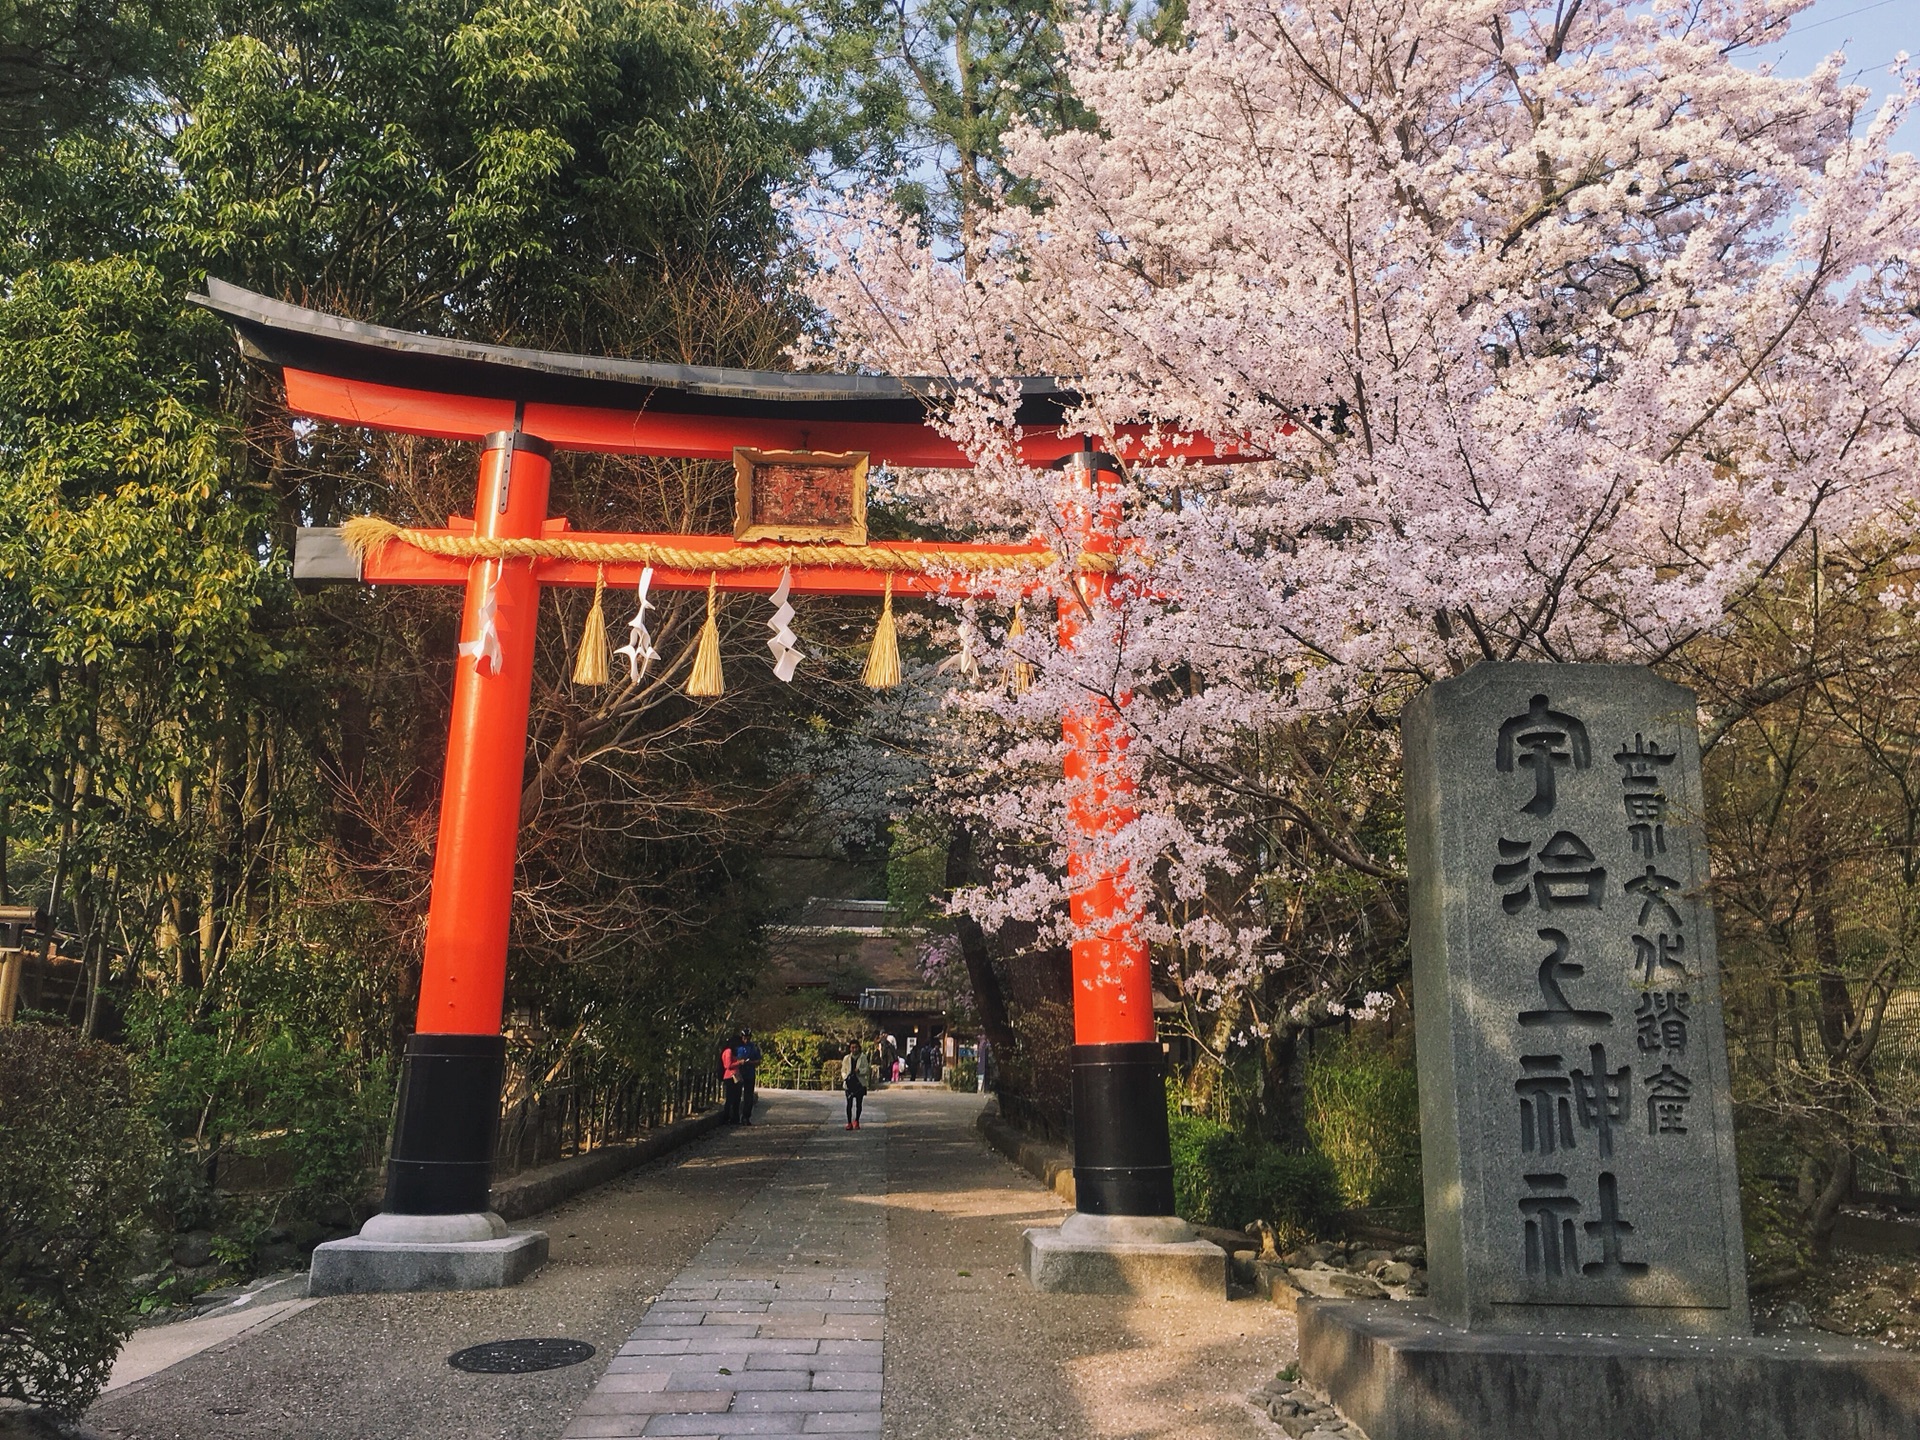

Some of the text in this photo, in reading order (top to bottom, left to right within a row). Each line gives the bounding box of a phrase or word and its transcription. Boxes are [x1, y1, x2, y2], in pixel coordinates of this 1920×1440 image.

[1492, 693, 1650, 1280] 宇治上神社
[1613, 732, 1692, 1136] 世界文化遺産
